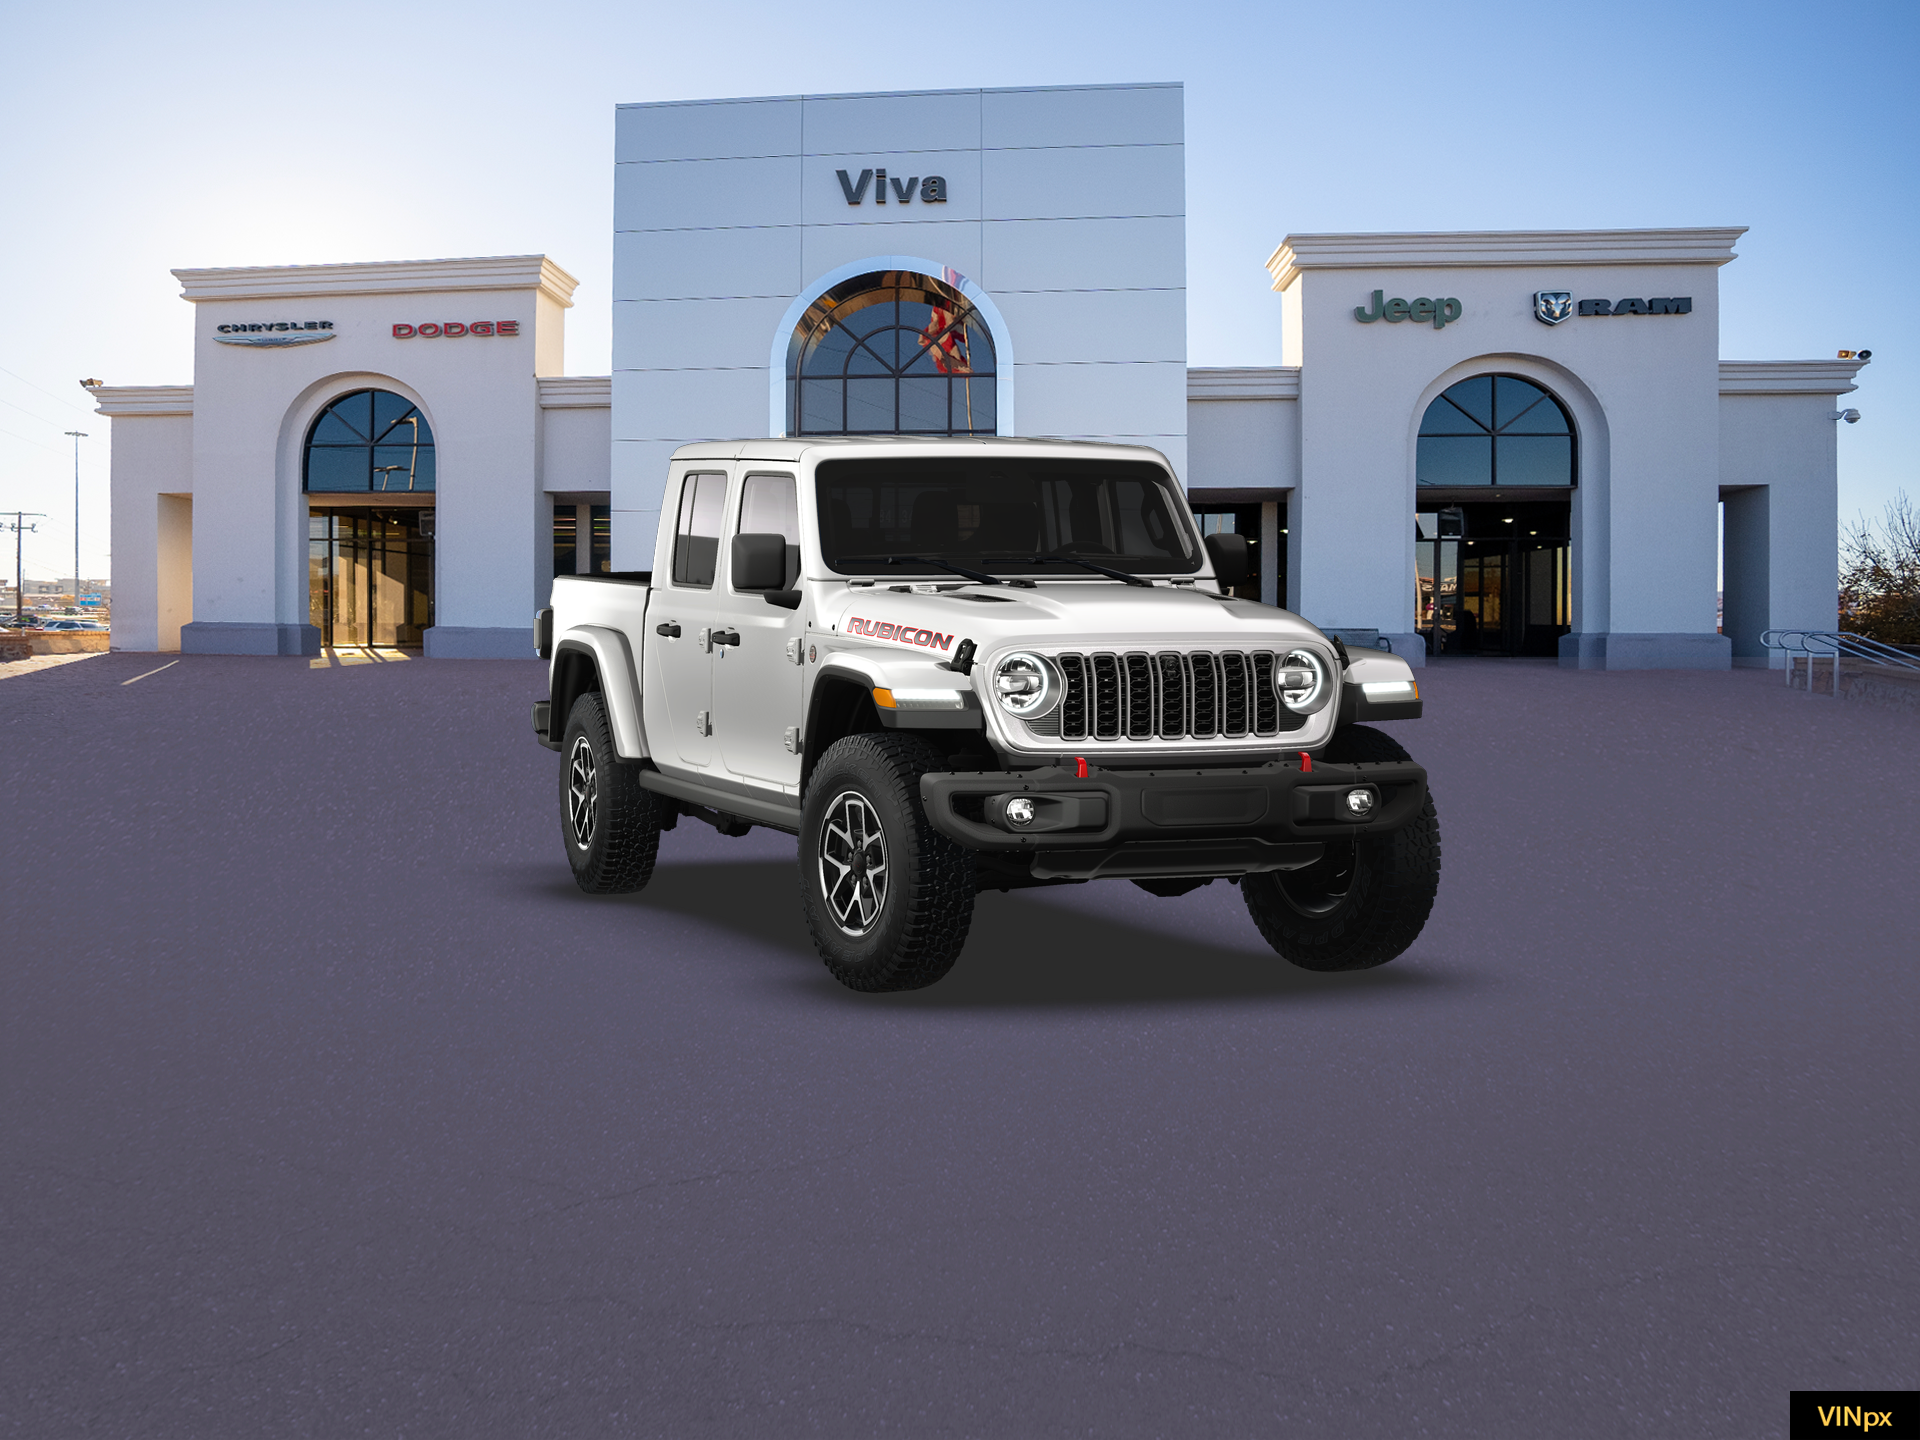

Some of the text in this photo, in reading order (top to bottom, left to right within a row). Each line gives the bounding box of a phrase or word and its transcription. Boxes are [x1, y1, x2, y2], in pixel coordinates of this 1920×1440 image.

[835, 168, 947, 205] Viva
[1354, 289, 1462, 329] Jeep
[1578, 297, 1692, 316] RAM
[217, 320, 334, 334] CHRYSLER
[392, 319, 520, 339] DODGE
[847, 617, 954, 651] RUBICON
[1266, 864, 1372, 945] WILDPEAK
